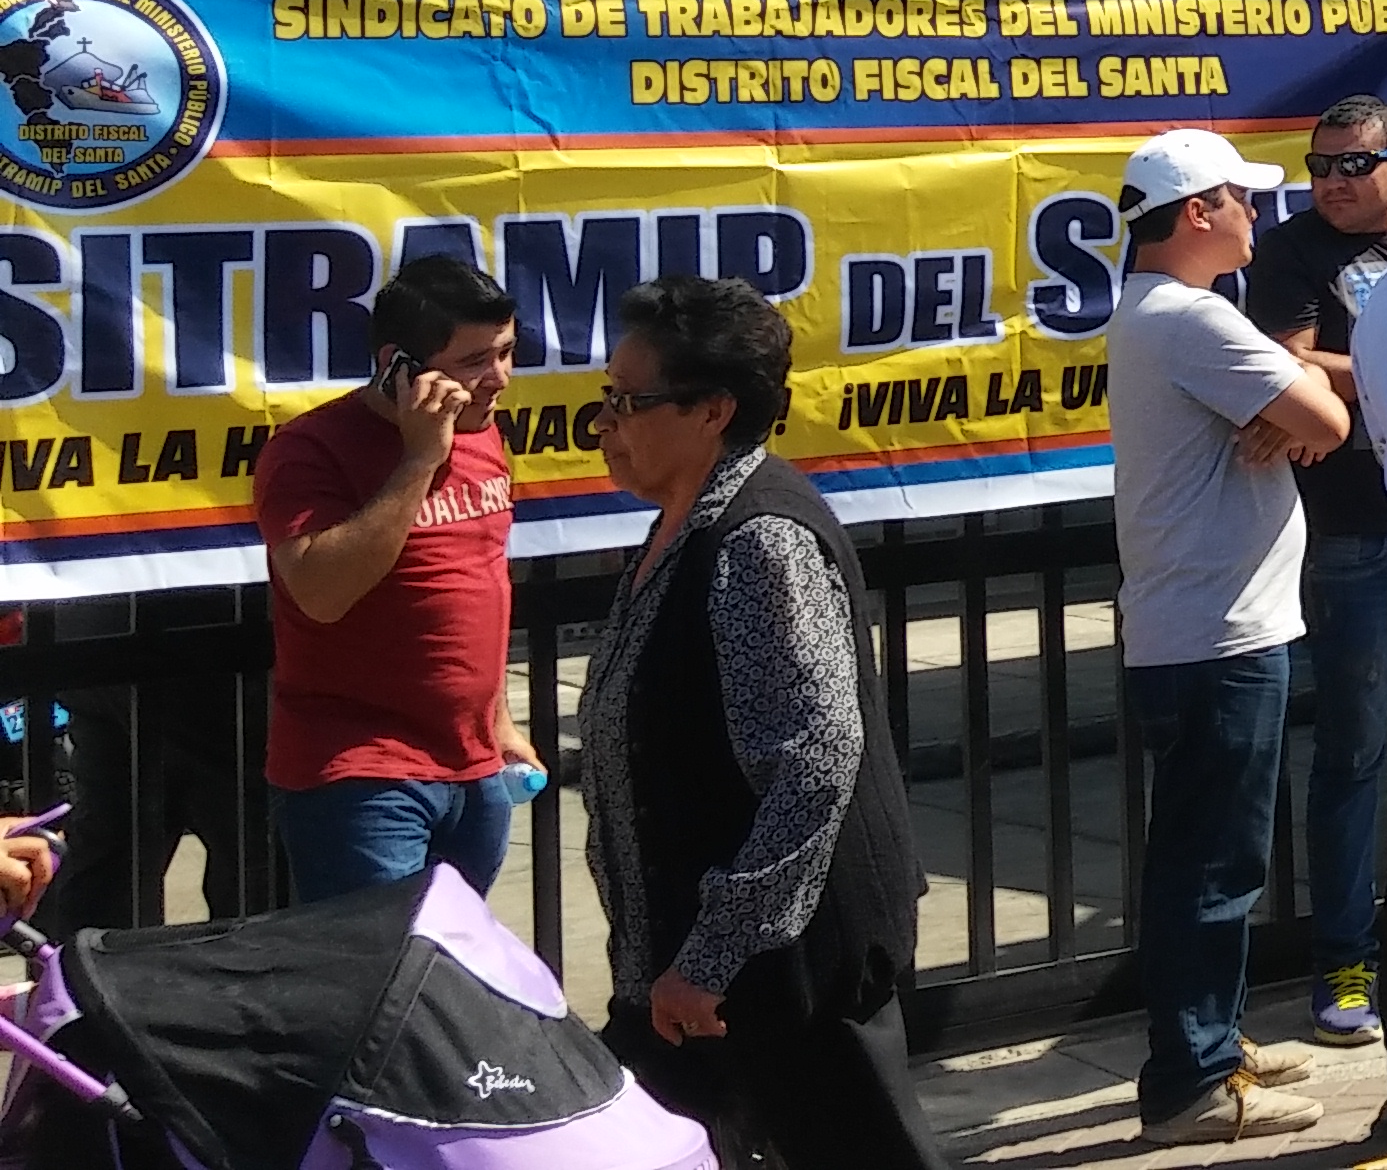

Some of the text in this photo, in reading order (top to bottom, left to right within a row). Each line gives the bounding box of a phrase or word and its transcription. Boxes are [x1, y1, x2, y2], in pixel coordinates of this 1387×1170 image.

[630, 55, 1230, 105] DISTRITO FISCAL DEL SANTA
[18, 124, 149, 141] DISTRITO FISCAL
[174, 81, 211, 146] PÚBLICO
[41, 147, 125, 164] DEL SANTA
[71, 178, 107, 199] DEL
[115, 152, 172, 190] SANTA
[847, 255, 1001, 348] DEL
[838, 374, 969, 430] ¡VIVA
[985, 369, 1043, 416] LA
[118, 429, 198, 484] LA
